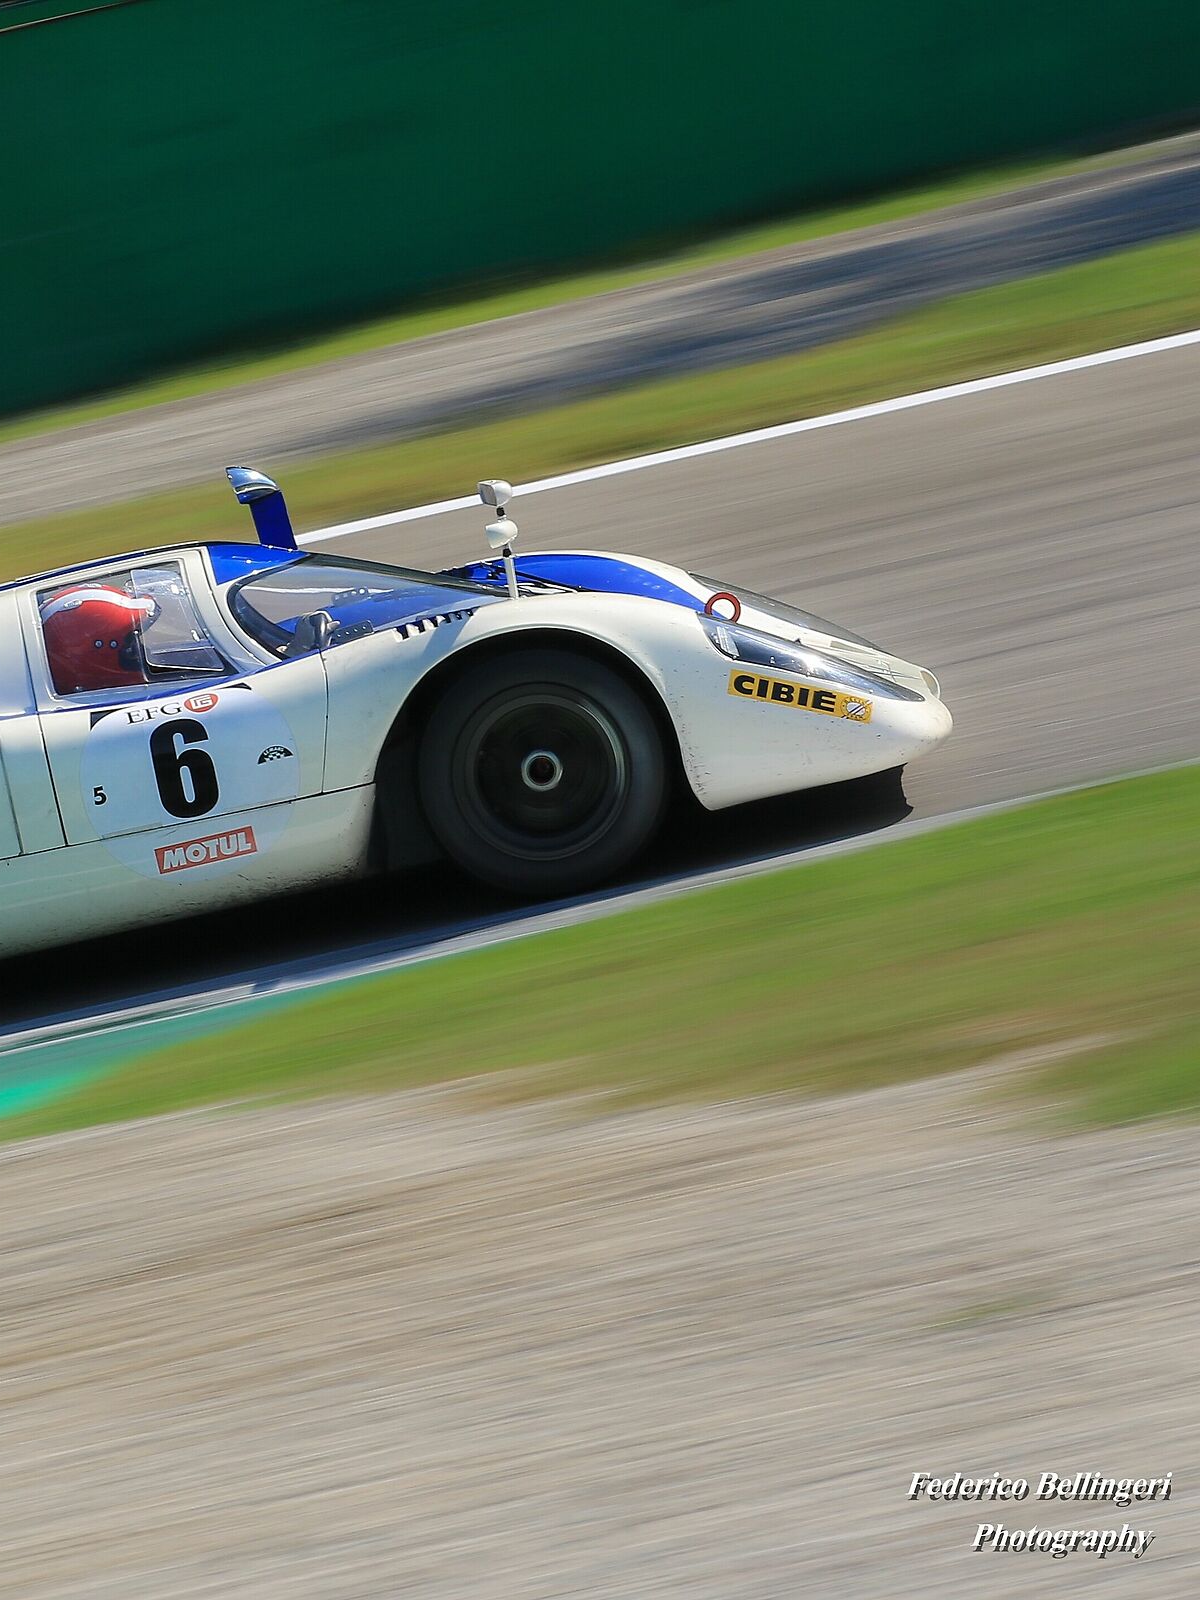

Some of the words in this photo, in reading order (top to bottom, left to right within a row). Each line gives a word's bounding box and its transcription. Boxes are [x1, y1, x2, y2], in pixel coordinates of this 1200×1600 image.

[126, 702, 182, 725] EFG
[149, 718, 220, 819] 6
[92, 786, 107, 806] 5
[163, 832, 252, 870] MOTUL
